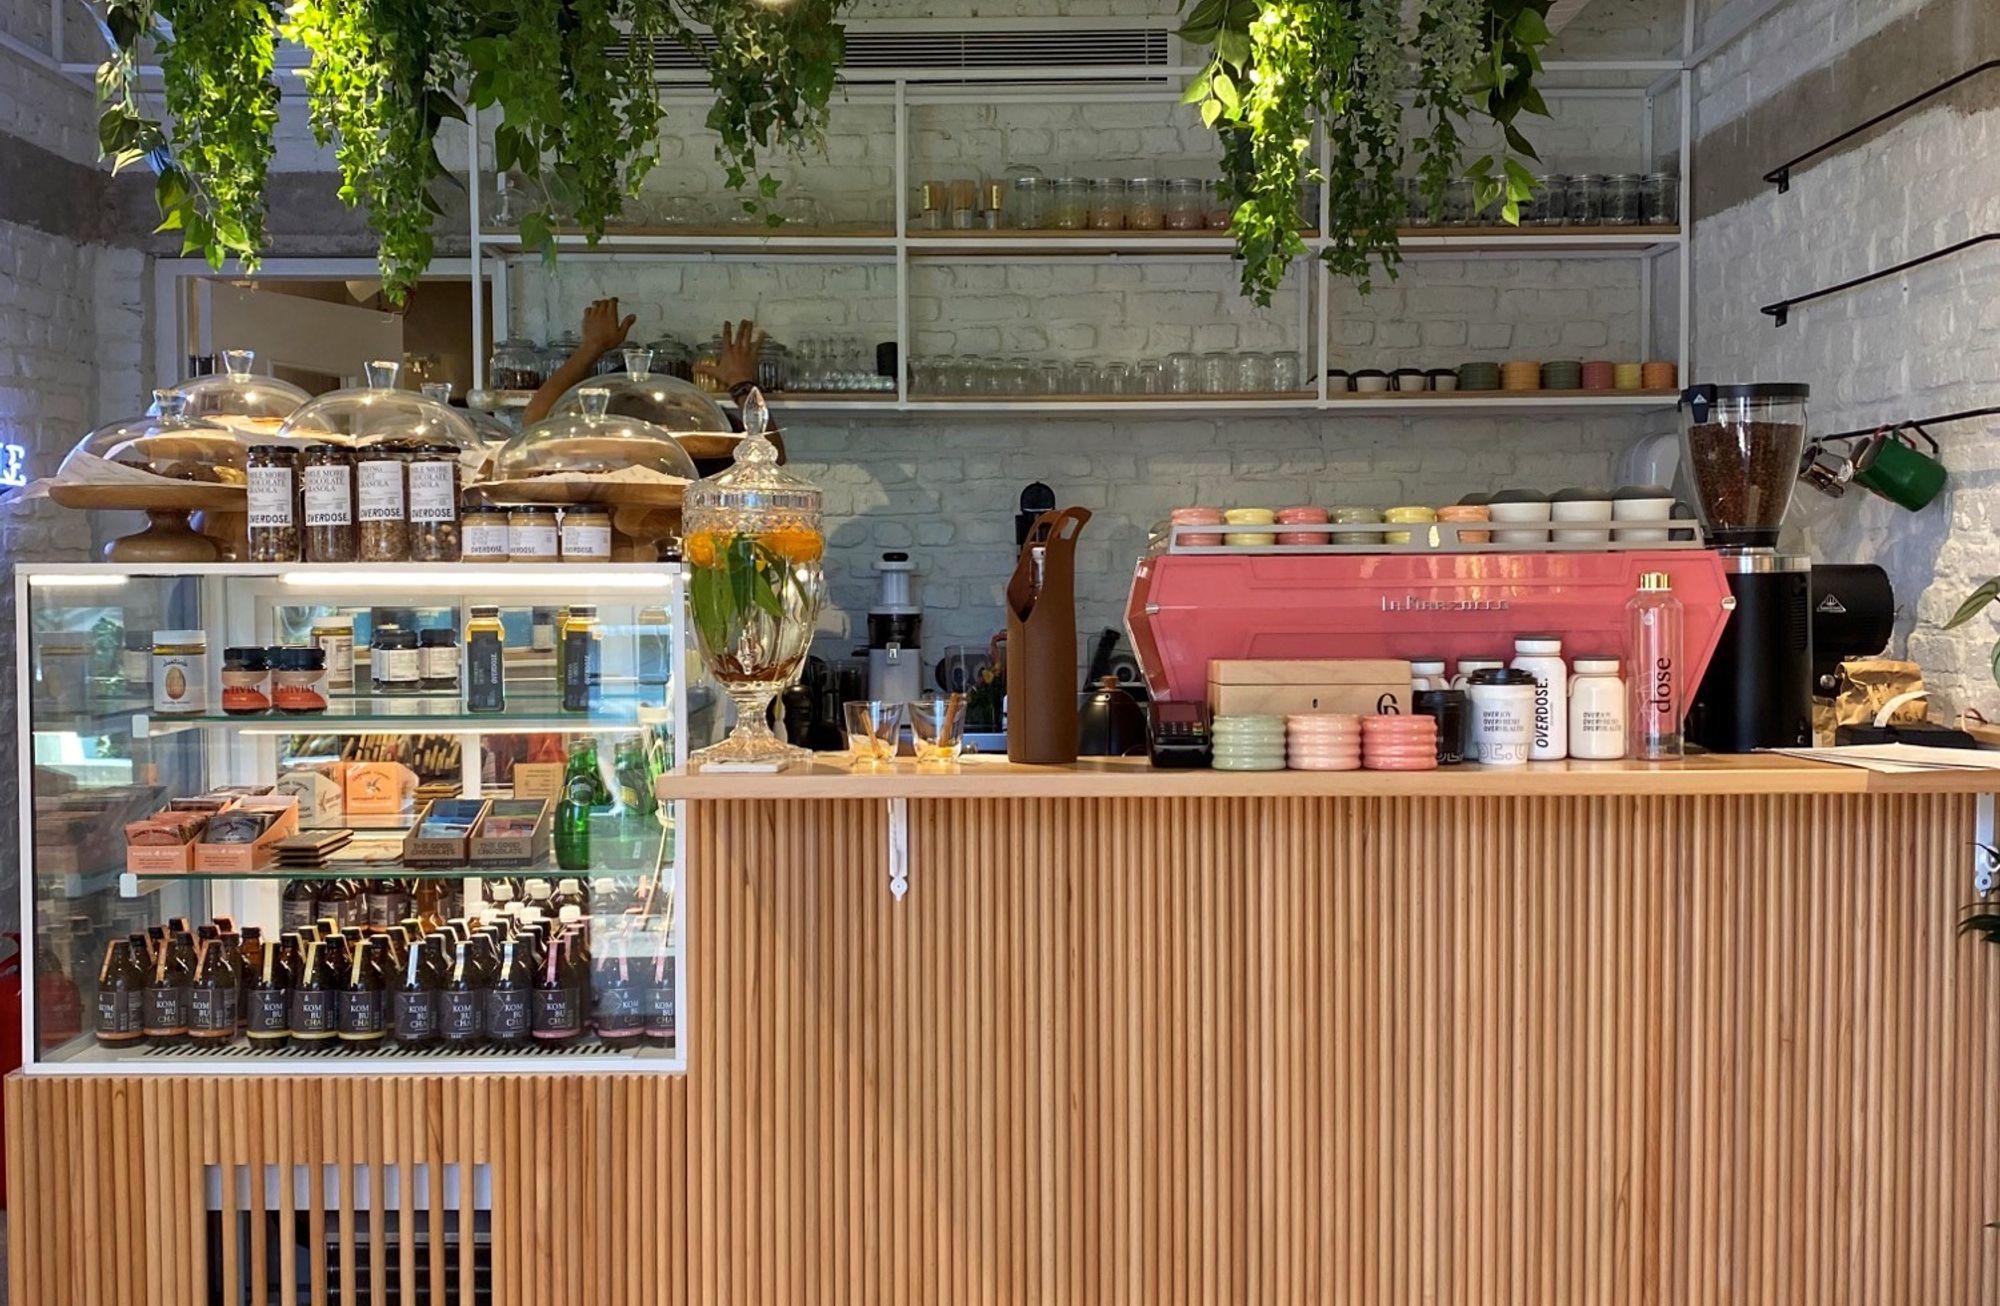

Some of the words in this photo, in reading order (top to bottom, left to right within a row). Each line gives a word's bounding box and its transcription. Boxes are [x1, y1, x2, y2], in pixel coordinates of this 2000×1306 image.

[1649, 657, 1672, 713] dose
[1534, 677, 1549, 749] OVERDOSE.
[156, 1001, 176, 1009] KOM
[264, 1003, 283, 1011] KOM
[303, 1004, 322, 1012] KOM
[350, 1004, 369, 1012] KOM
[409, 1005, 427, 1013] KOM
[453, 1004, 472, 1012] KOM
[546, 1002, 565, 1011] KOM
[655, 1001, 673, 1010] KOM
